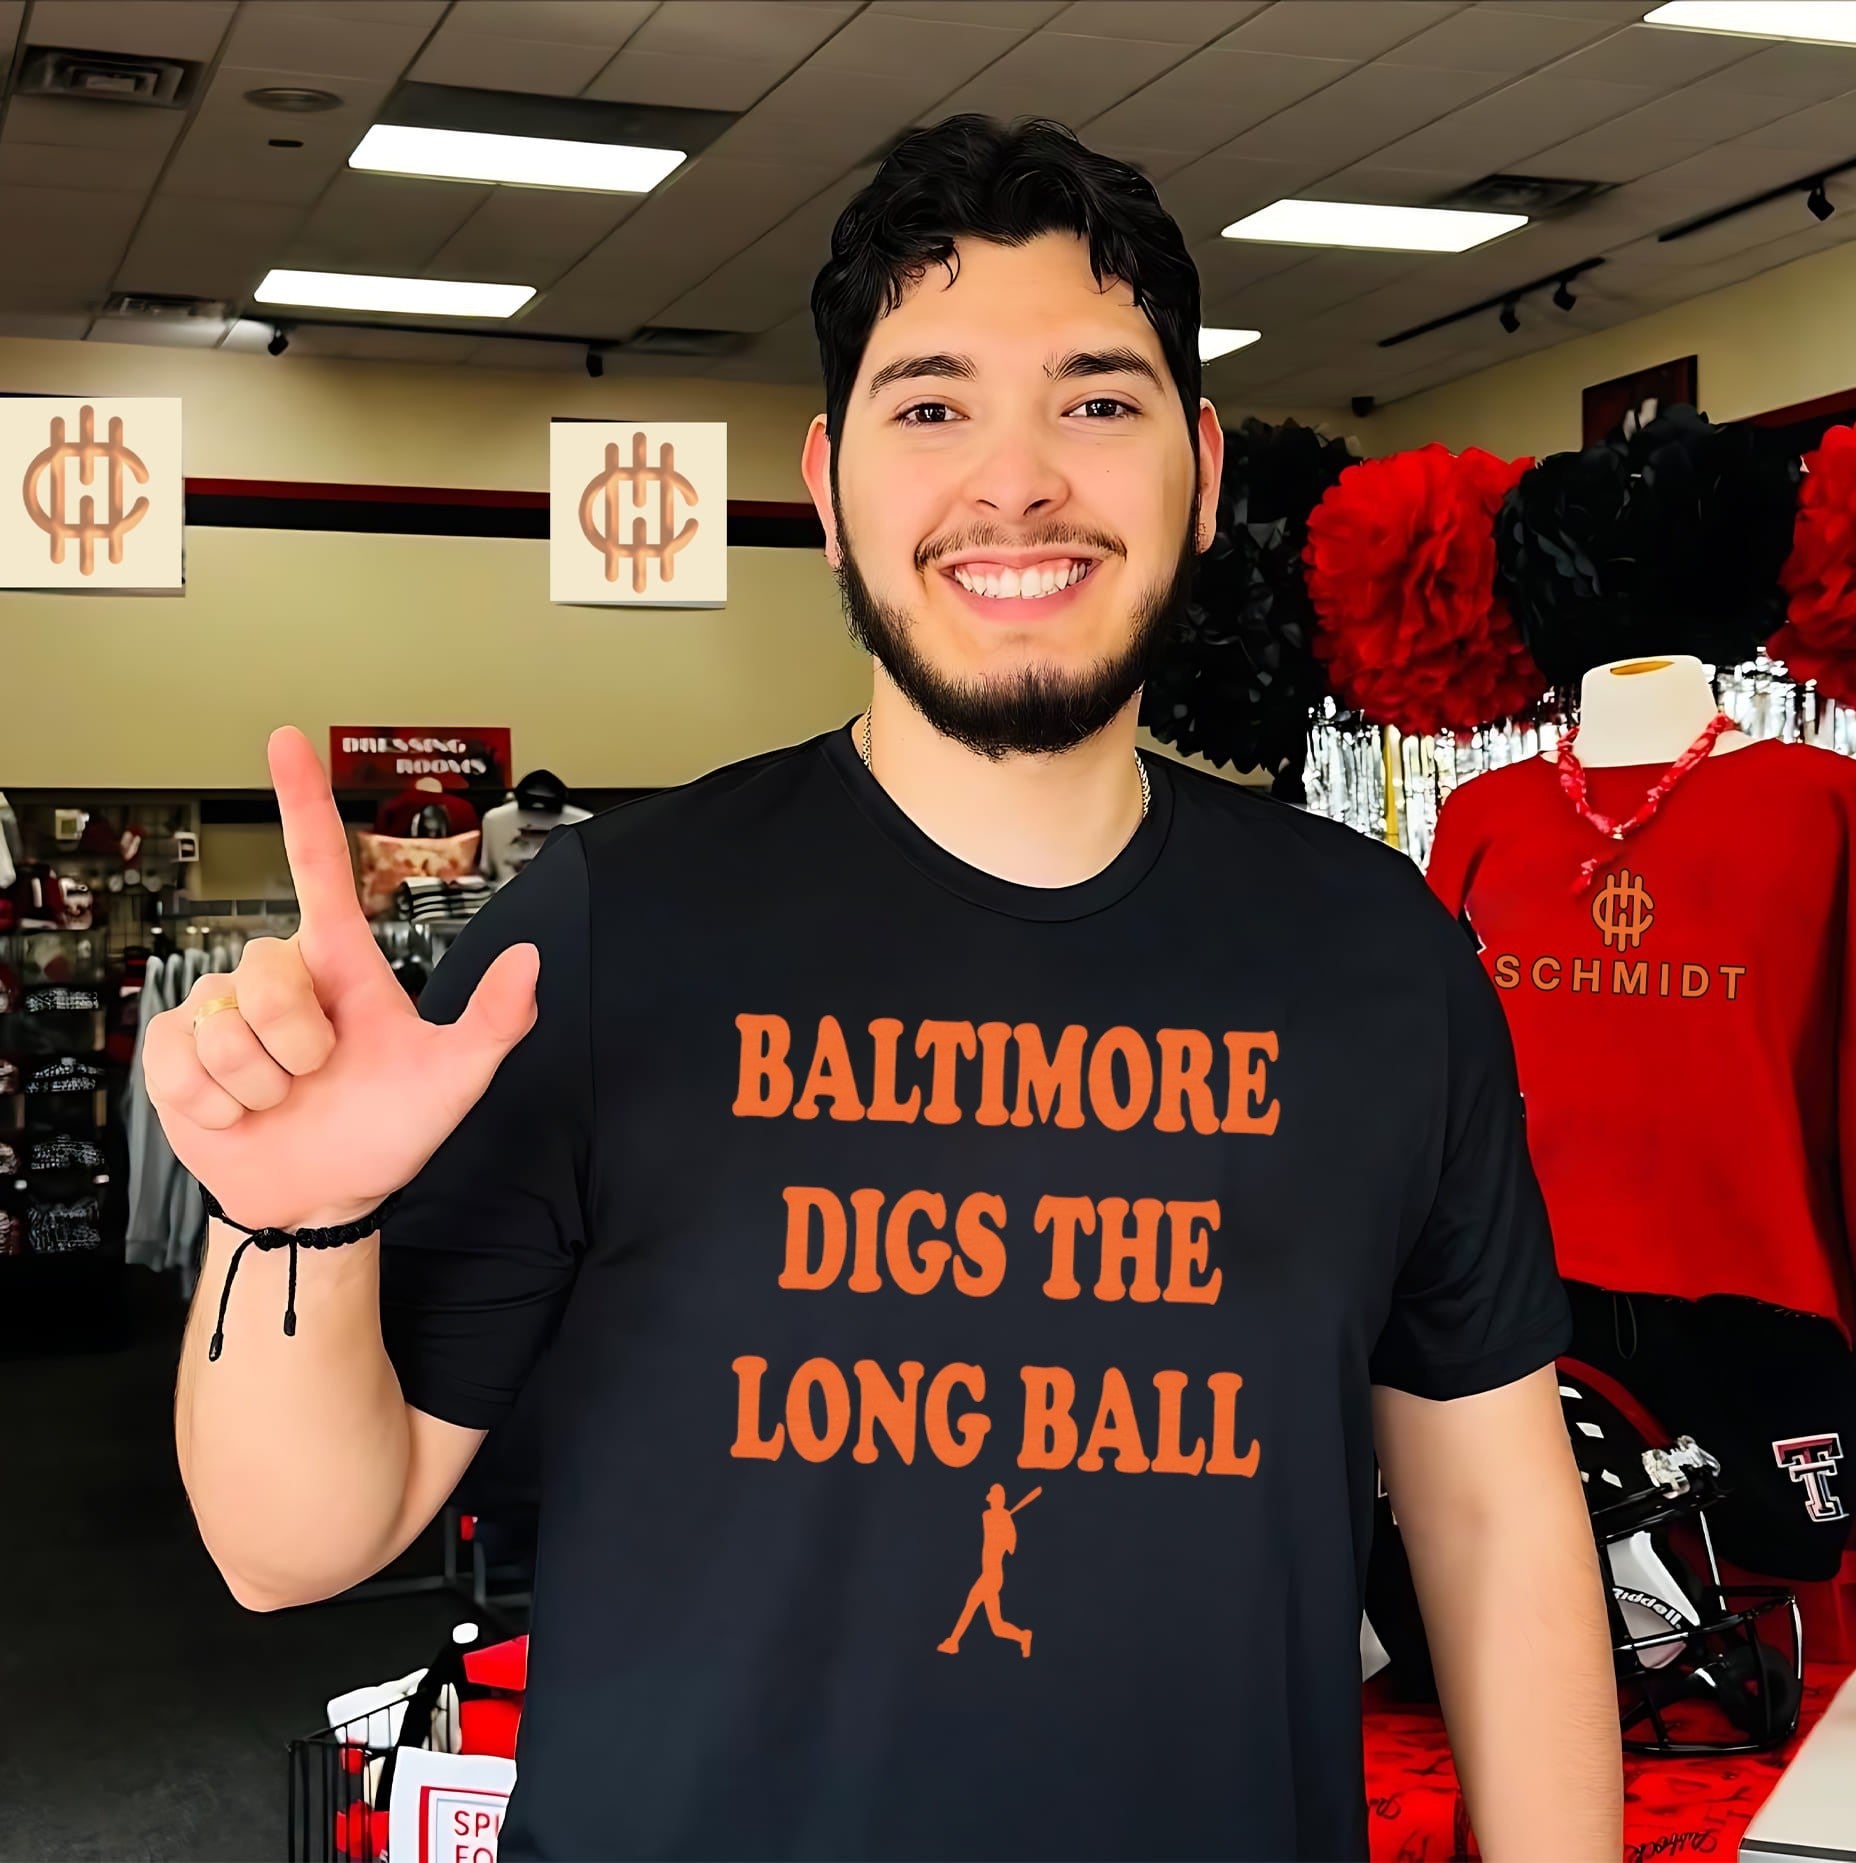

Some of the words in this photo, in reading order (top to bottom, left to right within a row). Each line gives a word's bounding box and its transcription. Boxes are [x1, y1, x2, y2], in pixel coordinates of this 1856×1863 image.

[396, 758, 487, 775] ROOMS
[1494, 953, 1748, 1000] SCHMIDT
[732, 1013, 1280, 1136] BALTIMORE
[778, 1186, 1007, 1297] DIGS
[1033, 1194, 1223, 1305] THE
[730, 1355, 992, 1468] LONG
[1016, 1365, 1260, 1478] BALL
